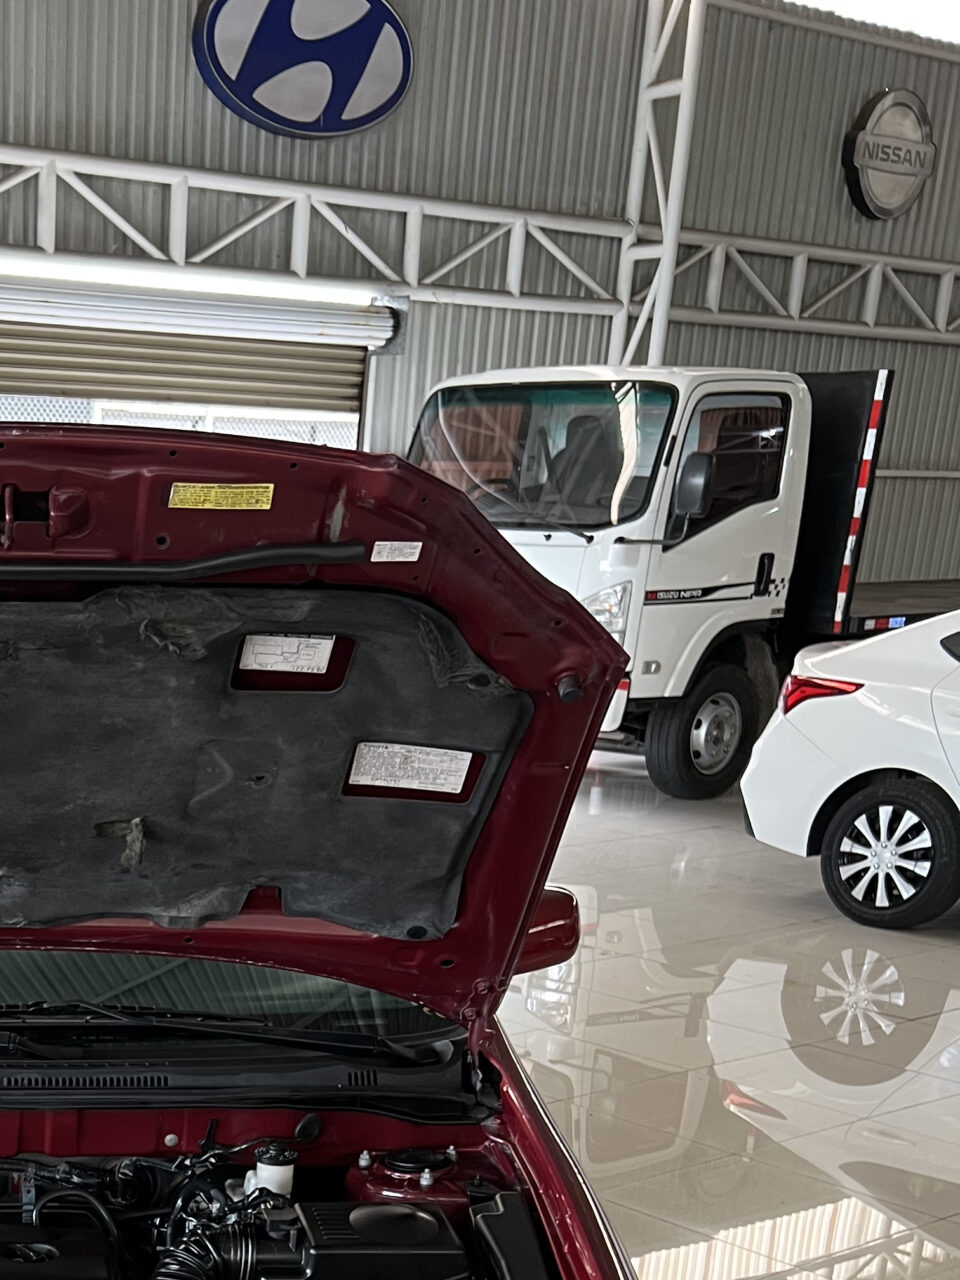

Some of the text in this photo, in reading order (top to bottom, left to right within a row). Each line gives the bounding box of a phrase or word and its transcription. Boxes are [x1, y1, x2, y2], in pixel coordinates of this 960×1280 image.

[862, 141, 927, 169] NISSAN
[656, 589, 702, 599] ISUZU NPR
